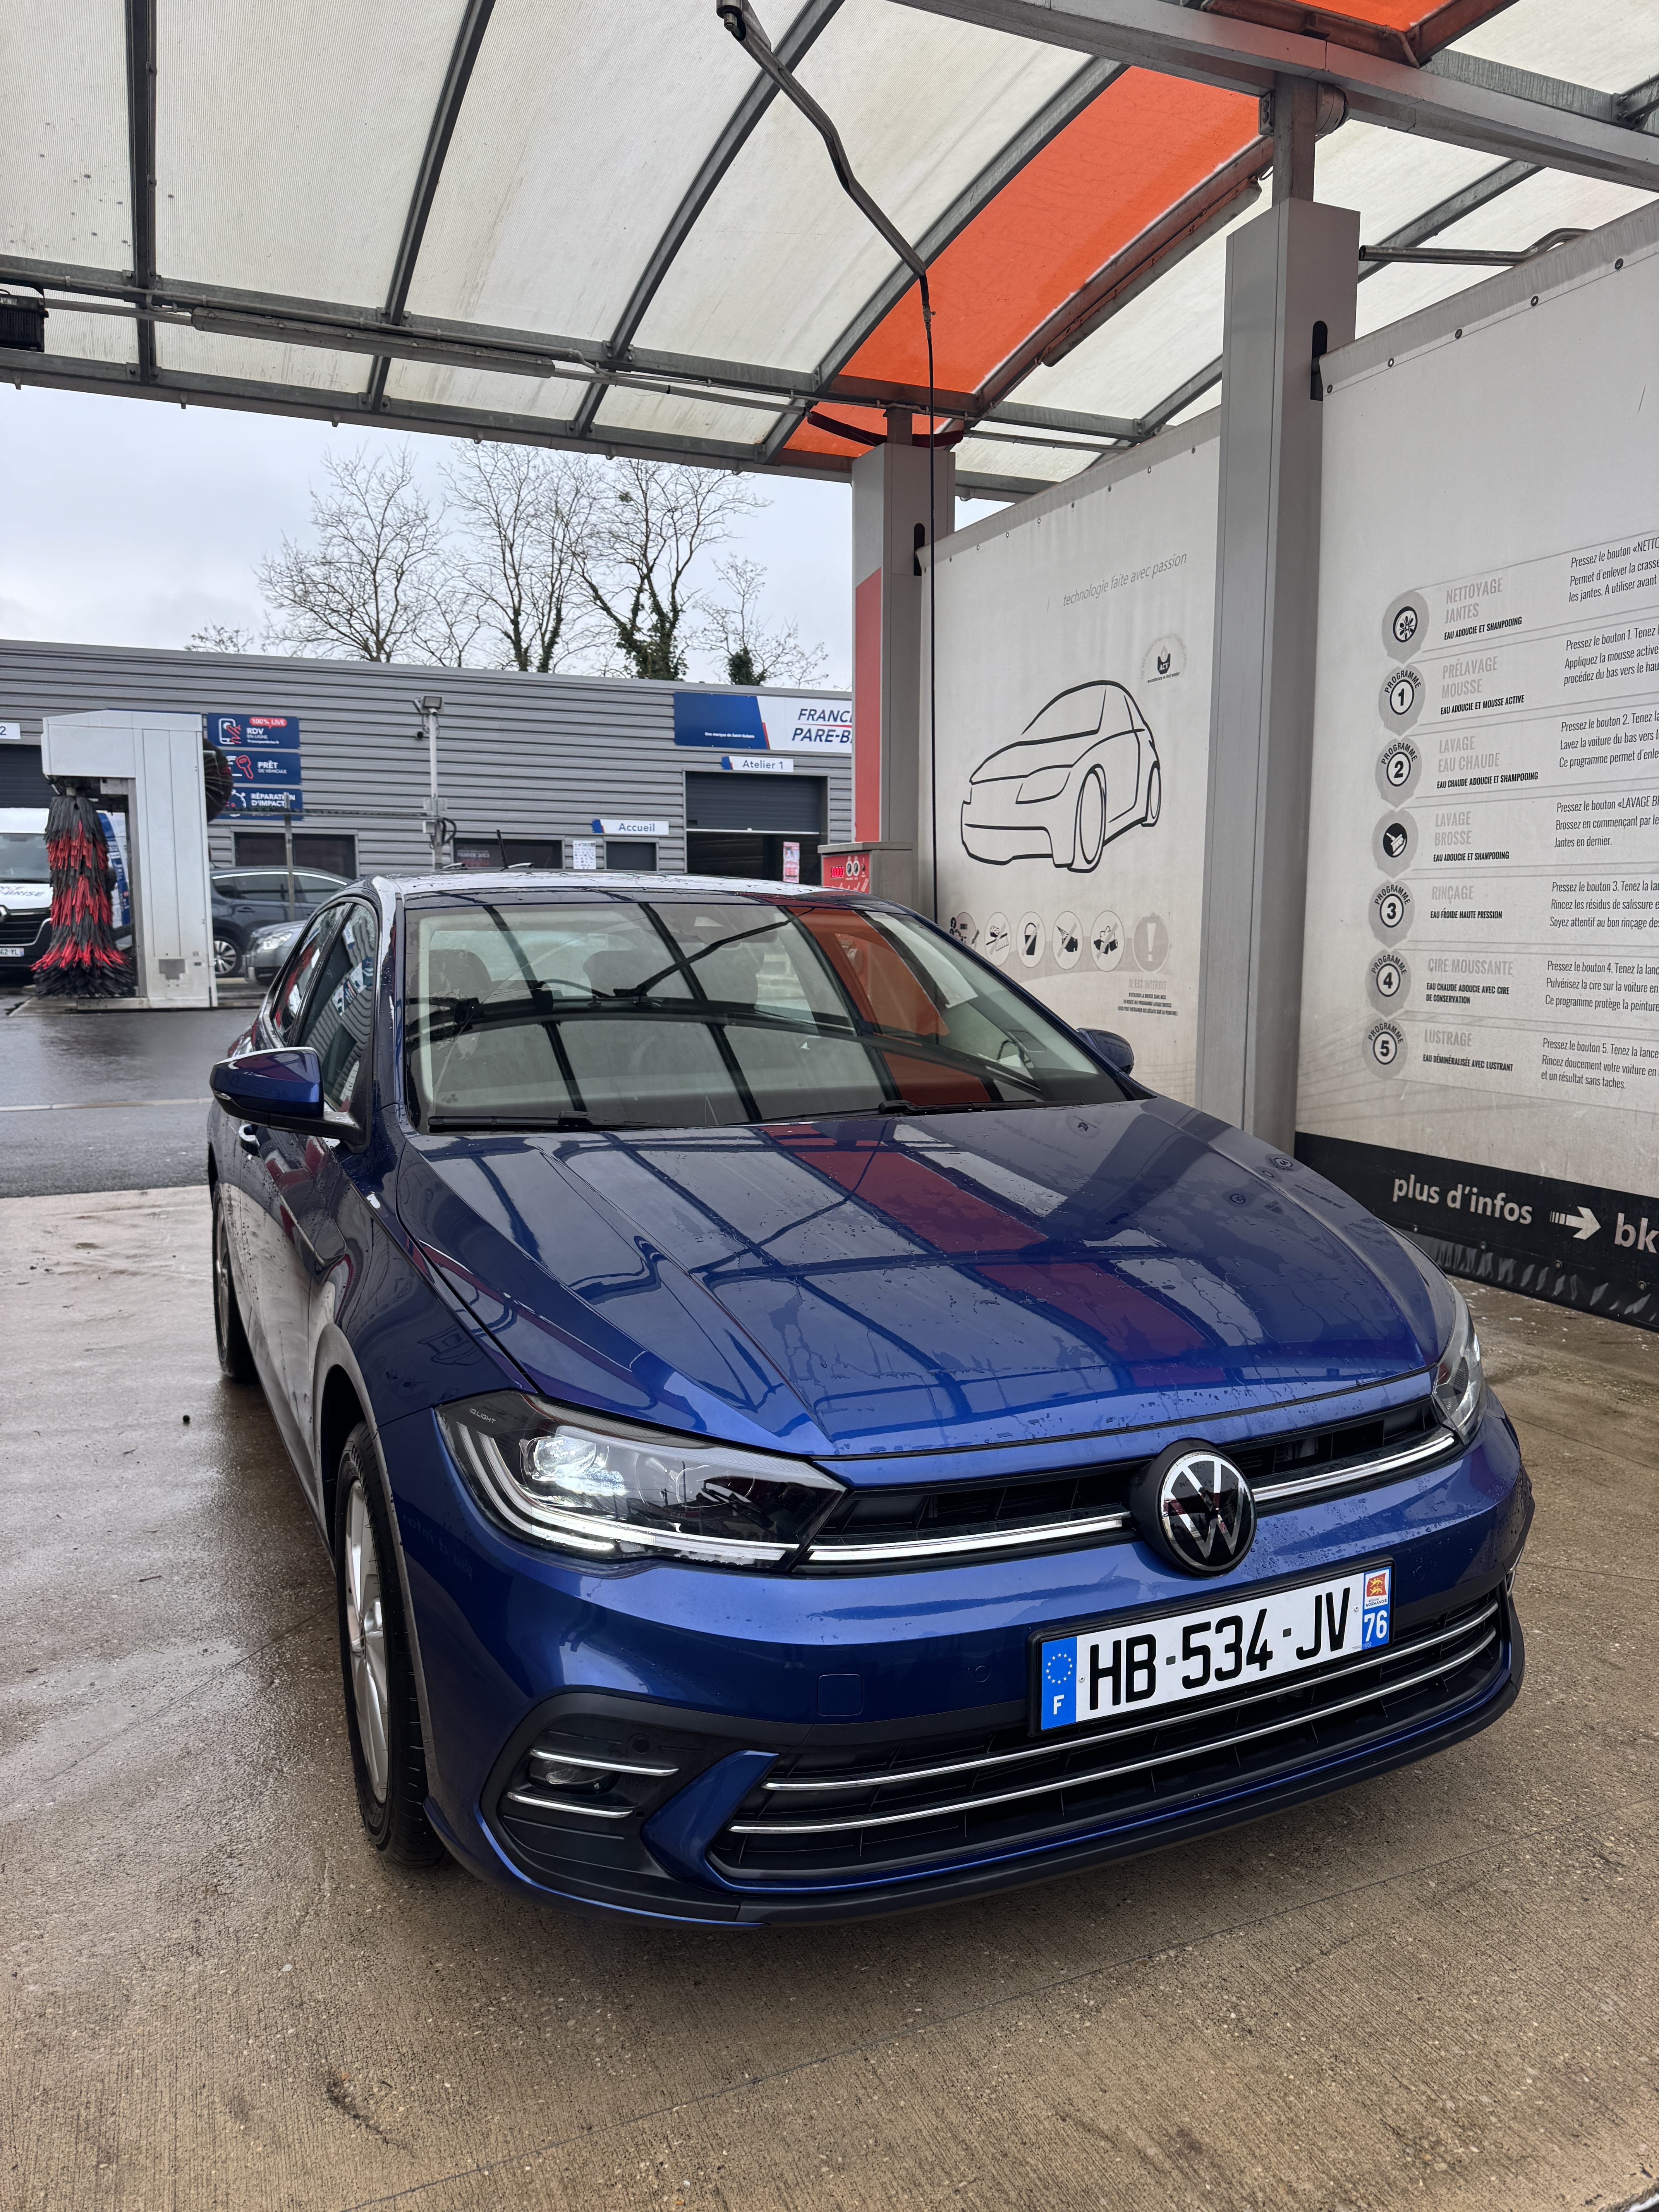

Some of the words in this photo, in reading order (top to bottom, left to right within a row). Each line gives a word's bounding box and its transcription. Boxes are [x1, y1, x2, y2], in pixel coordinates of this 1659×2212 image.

[1571, 555, 1597, 568] Pressez
[1599, 551, 1605, 562] le
[1607, 546, 1631, 560] bouton
[1063, 580, 1109, 606] technologie
[1111, 574, 1129, 590] faite
[1131, 567, 1151, 582] avec
[1152, 553, 1187, 579] passion
[1570, 572, 1594, 587] Permet
[1596, 566, 1628, 580] d'enlever
[1629, 563, 1635, 573] la
[1446, 577, 1503, 604] NETTOYAGE
[1569, 592, 1578, 602] les
[1580, 588, 1602, 602] jantes.
[1605, 584, 1609, 595] A
[1612, 580, 1635, 593] utiliser
[1637, 574, 1657, 588] avant
[1445, 603, 1479, 624] JANTES
[1444, 631, 1454, 640] EAU
[1455, 625, 1477, 638] ADOUCIE
[1479, 624, 1486, 633] ET
[1487, 617, 1522, 631] SHAMPOOING
[1443, 656, 1498, 679] PRÉLAVAGE
[1384, 670, 1421, 693] PROGRAMME
[1442, 678, 1482, 699] MOUSSE
[1398, 688, 1405, 706] 1
[1441, 706, 1450, 714] EAU
[1451, 703, 1473, 713] ADOUCIE
[1475, 701, 1481, 709] ET
[1483, 698, 1504, 709] MOUSSE
[1505, 695, 1525, 706] ACTIVE
[798, 709, 852, 723] FRANC
[0, 726, 7, 735] 2
[792, 728, 852, 743] PARE-B
[1381, 742, 1418, 764] PROGRAMME
[1439, 736, 1475, 754] LAVAGE
[257, 760, 278, 769] PRÊT
[743, 760, 775, 769] Atelier
[1394, 761, 1404, 778] 2
[1438, 757, 1455, 773] EAU
[1459, 753, 1500, 771] CHAUDE
[1448, 778, 1468, 788] CHAUDE
[1469, 776, 1492, 786] ADOUCIE
[1500, 772, 1538, 783] SHAMPOOING
[1557, 802, 1582, 812] Pressez
[1583, 800, 1590, 811] le
[1592, 800, 1616, 810] bouton
[618, 823, 655, 831] Accueil
[1436, 811, 1471, 827] LAVAGE
[1556, 820, 1581, 830] Brossez
[1593, 816, 1637, 829] commençant
[1640, 817, 1651, 828] par
[1434, 831, 1472, 846] BROSSE
[1554, 837, 1574, 847] Jantes
[1577, 838, 1584, 847] en
[1587, 836, 1612, 847] dernier.
[1444, 853, 1466, 862] ADOUCIE
[1475, 851, 1510, 860] SHAMPOOING
[1374, 884, 1410, 905] PROGRAMME
[1432, 886, 1474, 904] RINÇAGE
[1387, 902, 1396, 920] 3
[1371, 954, 1407, 975] PROGRAMME
[1428, 958, 1449, 972] CIRE
[1451, 959, 1513, 975] MOUSSANTE
[1135, 979, 1143, 989] EST
[1145, 980, 1166, 990] INTERDIT
[1383, 972, 1393, 989] 4
[1437, 983, 1457, 991] CHAUDE
[1458, 984, 1480, 993] ADOUCIE
[1497, 986, 1510, 994] CIRE
[1546, 977, 1580, 989] Pulvérisez
[1582, 979, 1587, 989] la
[1589, 980, 1601, 990] cire
[1603, 982, 1614, 991] sur
[1616, 981, 1621, 991] la
[1624, 982, 1647, 993] voiture
[1433, 994, 1470, 1004] CONSERVATION
[1368, 1023, 1403, 1044] PROGRAMME
[1424, 1029, 1472, 1046] LUSTRAGE
[1380, 1040, 1389, 1056] 5
[1543, 1038, 1568, 1050] Pressez
[1570, 1040, 1575, 1051] le
[1577, 1041, 1600, 1053] bouton
[1602, 1043, 1608, 1054] 5.
[1610, 1044, 1630, 1056] Tenez
[1632, 1046, 1637, 1056] la
[1640, 1046, 1659, 1059] lance
[1423, 1054, 1432, 1062] EAU
[1433, 1054, 1470, 1067] DÉMINÉRALISÉE
[1472, 1060, 1485, 1068] AVEC
[1486, 1061, 1513, 1072] LUSTRANT
[1542, 1055, 1563, 1066] Rincez
[1565, 1058, 1602, 1071] doucement
[1604, 1062, 1620, 1073] votre
[1622, 1064, 1646, 1075] voiture
[1648, 1068, 1656, 1077] en
[1541, 1070, 1547, 1080] et
[1549, 1073, 1557, 1081] un
[1559, 1072, 1583, 1084] résultat
[1585, 1077, 1601, 1086] sans
[1602, 1077, 1626, 1089] taches.
[1393, 1174, 1440, 1204] plus
[1446, 1184, 1533, 1224] d'infos
[470, 1408, 496, 1424] IQ.LIGHT
[1365, 1599, 1387, 1607] NORMANDIE
[1364, 1610, 1388, 1642] 76
[1053, 1695, 1064, 1715] F
